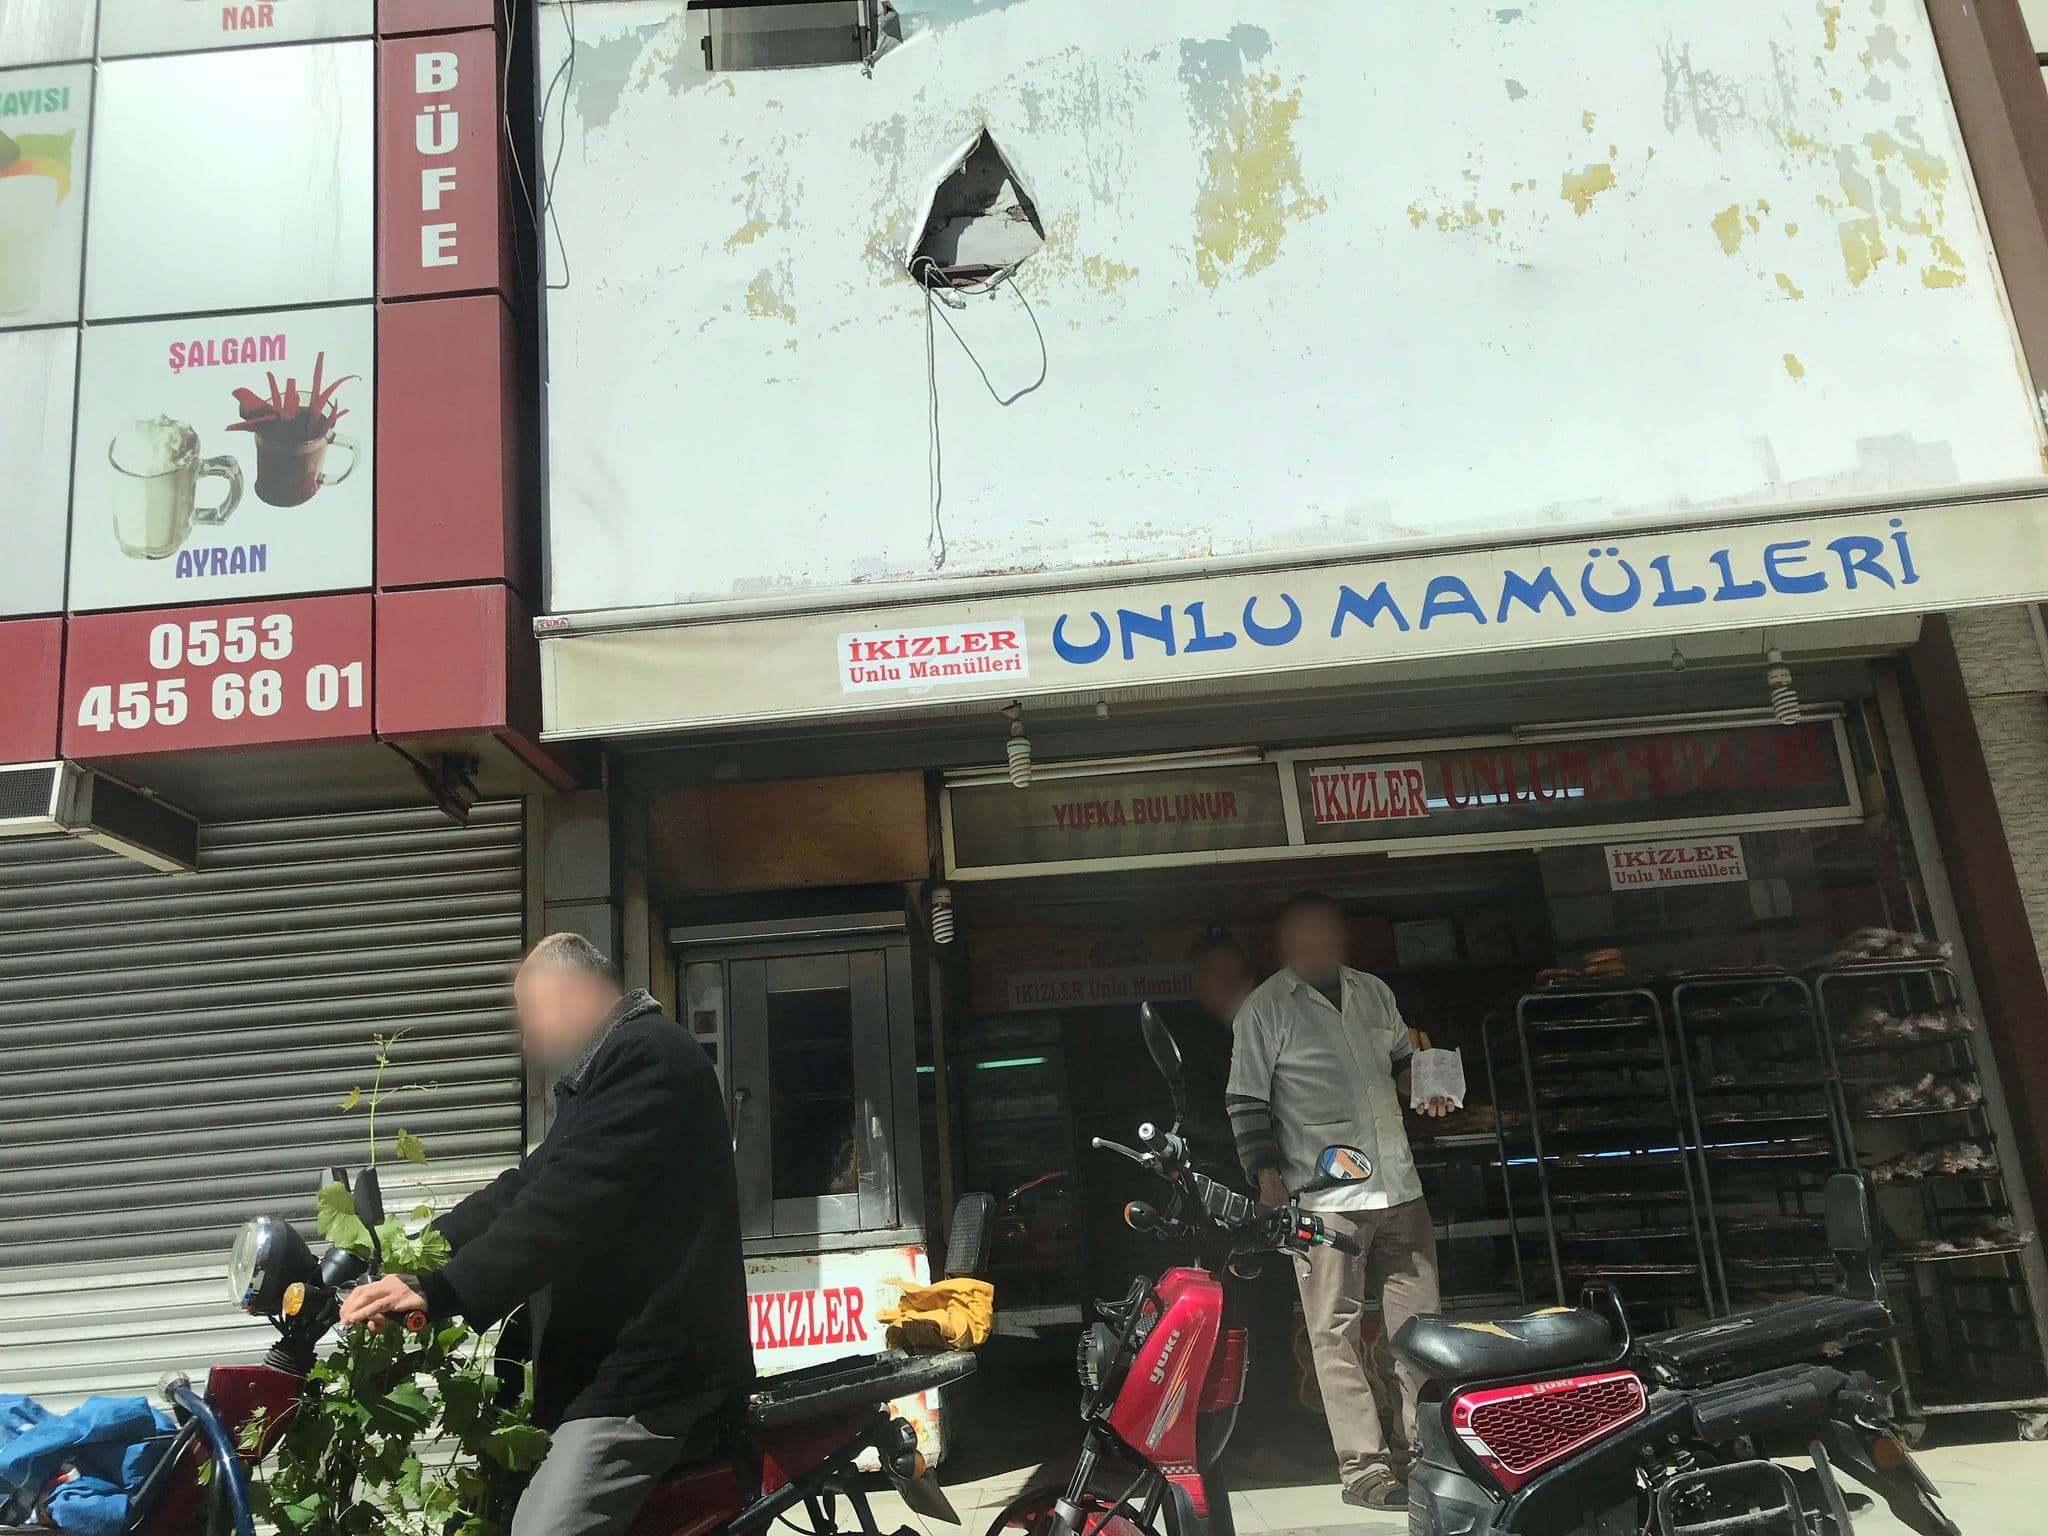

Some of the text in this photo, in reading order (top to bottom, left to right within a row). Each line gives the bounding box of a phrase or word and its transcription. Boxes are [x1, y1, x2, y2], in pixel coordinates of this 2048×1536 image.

[222, 4, 274, 31] NAR
[0, 87, 70, 117] AYISI
[415, 51, 460, 268] BÜFE
[169, 334, 287, 374] ŞALGAM
[175, 543, 267, 578] AYRAN
[1052, 518, 1920, 664] UNLU MAMÜLLERİ
[149, 614, 293, 669] 0553
[848, 630, 1020, 662] İKİZLER
[849, 653, 1022, 684] Unlu Mamülleri
[77, 662, 363, 732] 455 68 01
[1052, 791, 1237, 832] YUFKA BULUNUR
[1611, 844, 1738, 868] İKİZLER
[1615, 862, 1742, 884] Unlu Mamülleri
